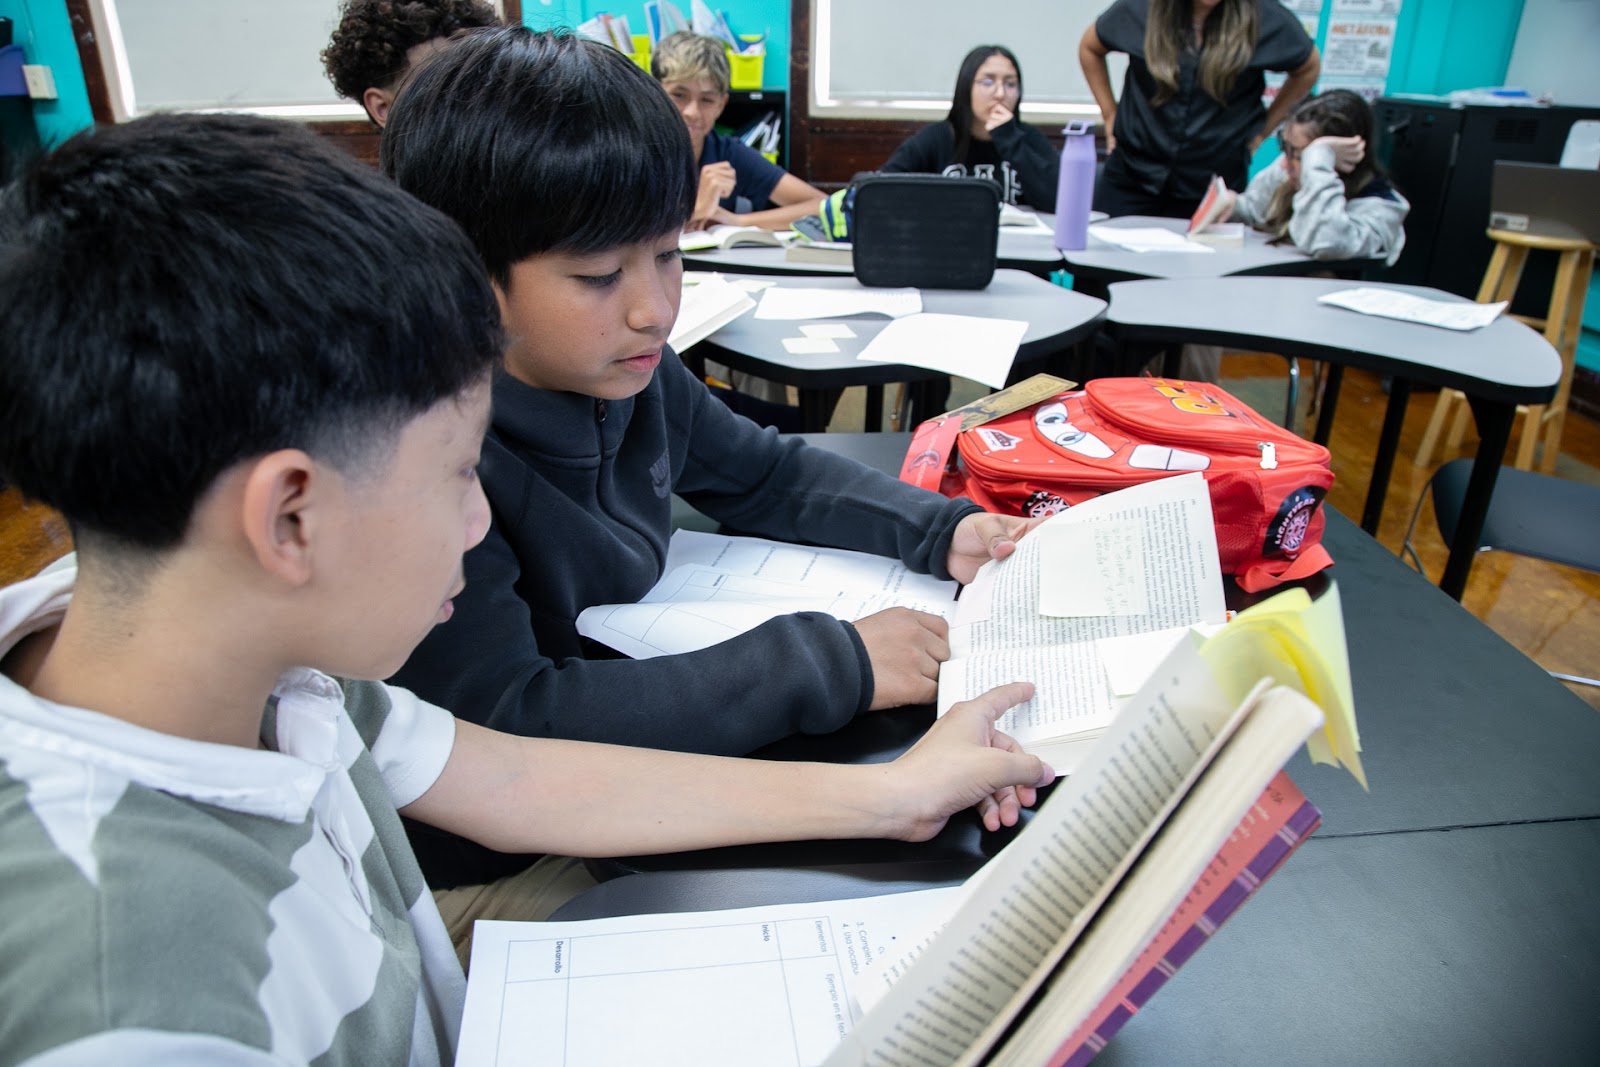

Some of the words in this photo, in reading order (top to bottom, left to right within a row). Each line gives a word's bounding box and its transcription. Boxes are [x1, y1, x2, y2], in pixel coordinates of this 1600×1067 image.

[761, 924, 771, 942] Inicio
[815, 920, 828, 953] Elementos
[844, 931, 853, 945] Usa
[554, 940, 564, 974] Desarrollo
[826, 973, 838, 1001] Ejemplo
[833, 1003, 841, 1013] en
